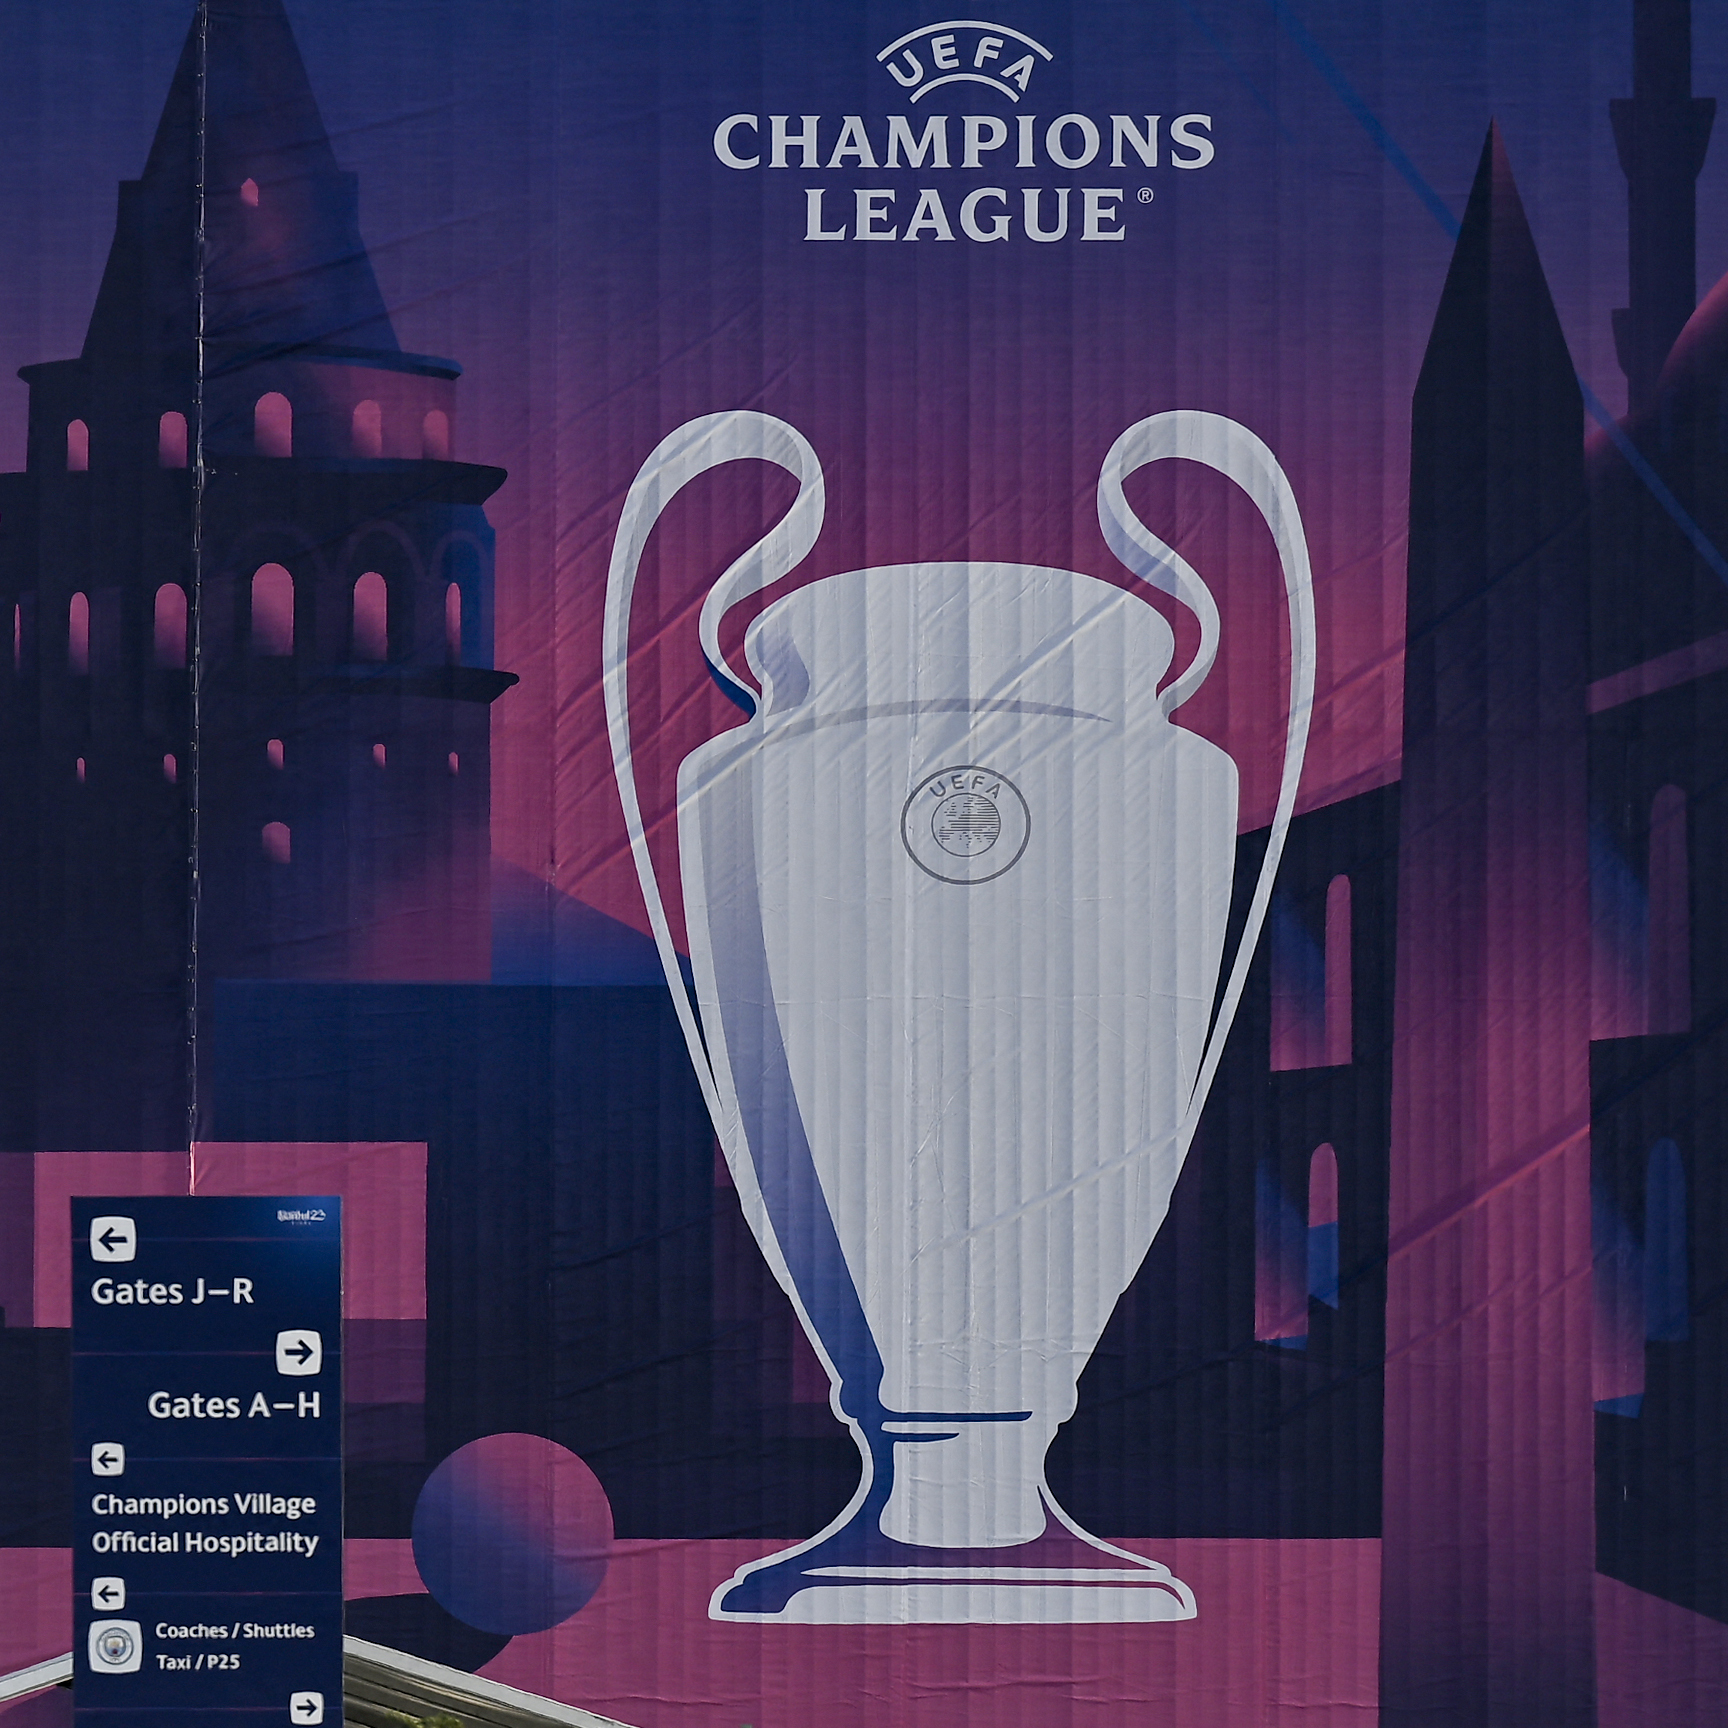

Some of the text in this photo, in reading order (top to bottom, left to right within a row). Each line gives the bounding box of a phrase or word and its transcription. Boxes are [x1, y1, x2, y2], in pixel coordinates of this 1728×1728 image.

[885, 34, 1035, 92] UEFA
[712, 113, 1215, 170] CHAMPIONS
[929, 774, 1001, 799] UEFA
[90, 1278, 184, 1305] Gates
[147, 1391, 241, 1419] Gates
[91, 1493, 317, 1520] Champions Village
[91, 1531, 320, 1558] Official Hospitality
[155, 1622, 229, 1639] Coaches
[243, 1622, 315, 1639] Shuttles
[155, 1654, 191, 1670] Taxi
[207, 1654, 240, 1671] P25
